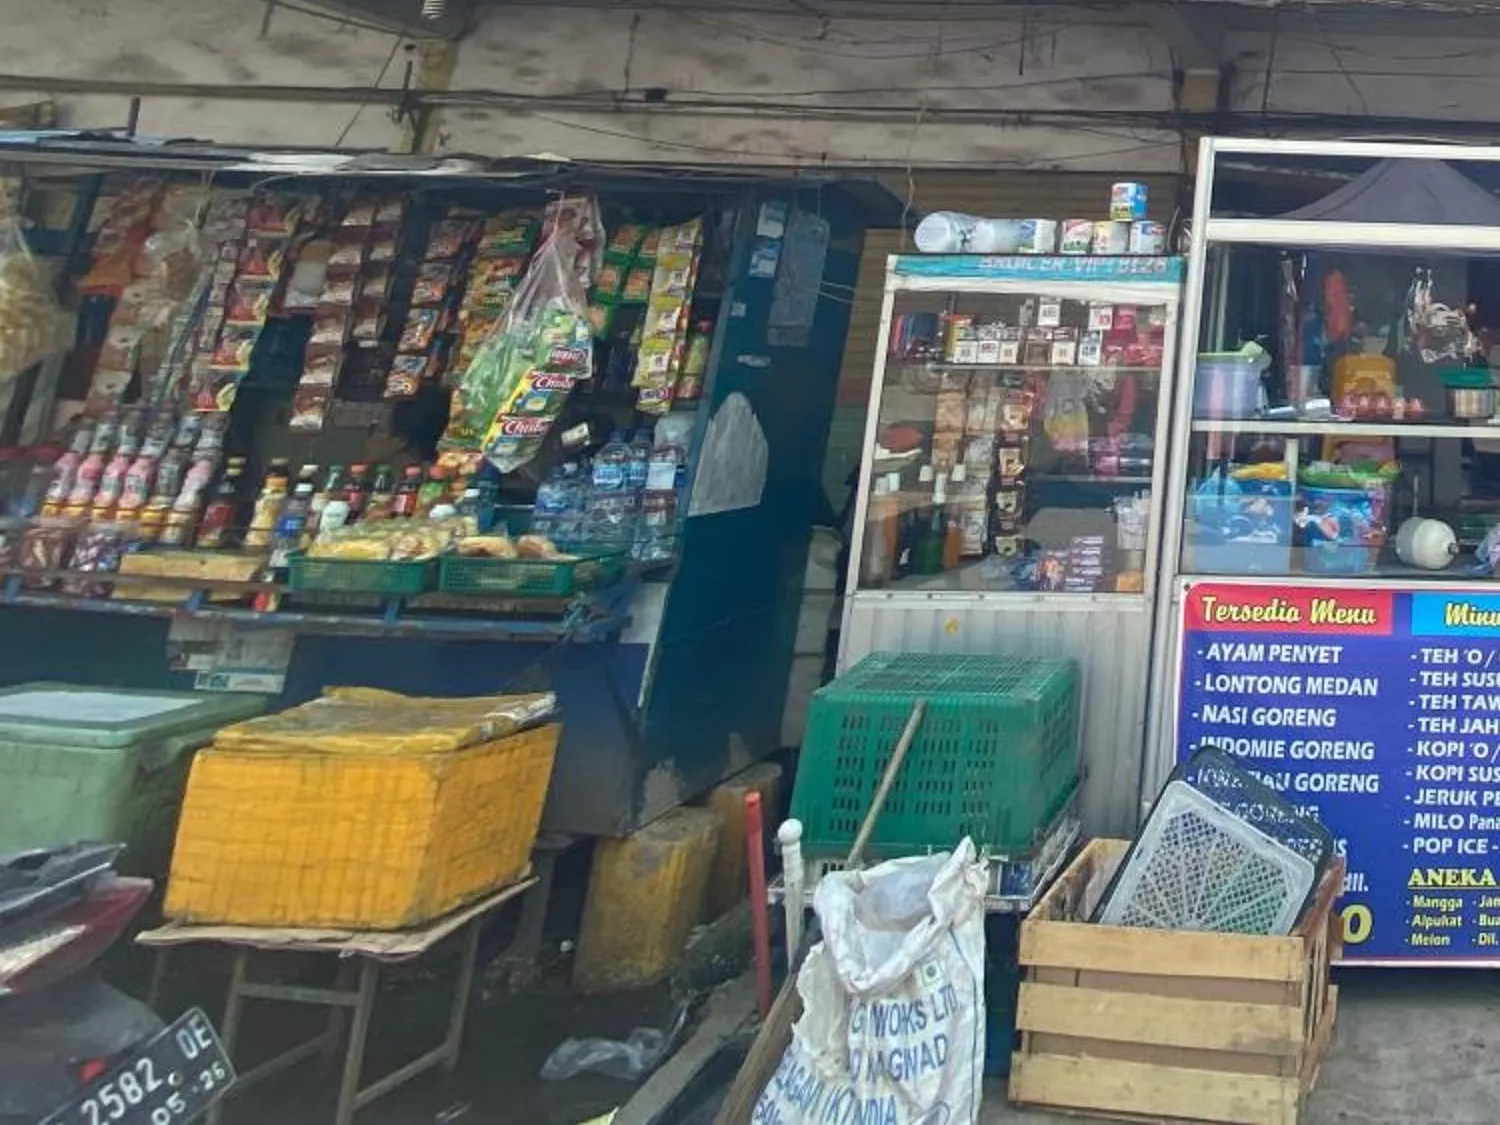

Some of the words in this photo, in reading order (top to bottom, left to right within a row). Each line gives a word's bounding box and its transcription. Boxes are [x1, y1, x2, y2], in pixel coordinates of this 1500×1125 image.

[1202, 596, 1302, 622] Tersedia
[1310, 599, 1377, 624] Menu
[1206, 643, 1264, 662] AYAM
[1269, 644, 1342, 664] PENYET
[1421, 648, 1458, 664] TEH
[1205, 673, 1301, 695] LONTONG
[1306, 677, 1378, 696] MEDAN
[1420, 672, 1457, 687] TEH
[1419, 694, 1457, 710] TEH
[1202, 705, 1247, 725] NASI
[1252, 707, 1336, 728] GORENG
[1418, 717, 1456, 733] TEH
[1290, 741, 1374, 760] GORENG
[1417, 740, 1464, 758] KOPI
[1415, 764, 1463, 782] KOPI
[1294, 774, 1379, 793] GORENG
[1413, 788, 1477, 806] JERUK
[1413, 812, 1464, 830] MILO
[1413, 837, 1453, 854] POP
[1457, 838, 1489, 854] ICE
[1408, 867, 1497, 887] ANEKA
[1413, 895, 1463, 912] Mangga
